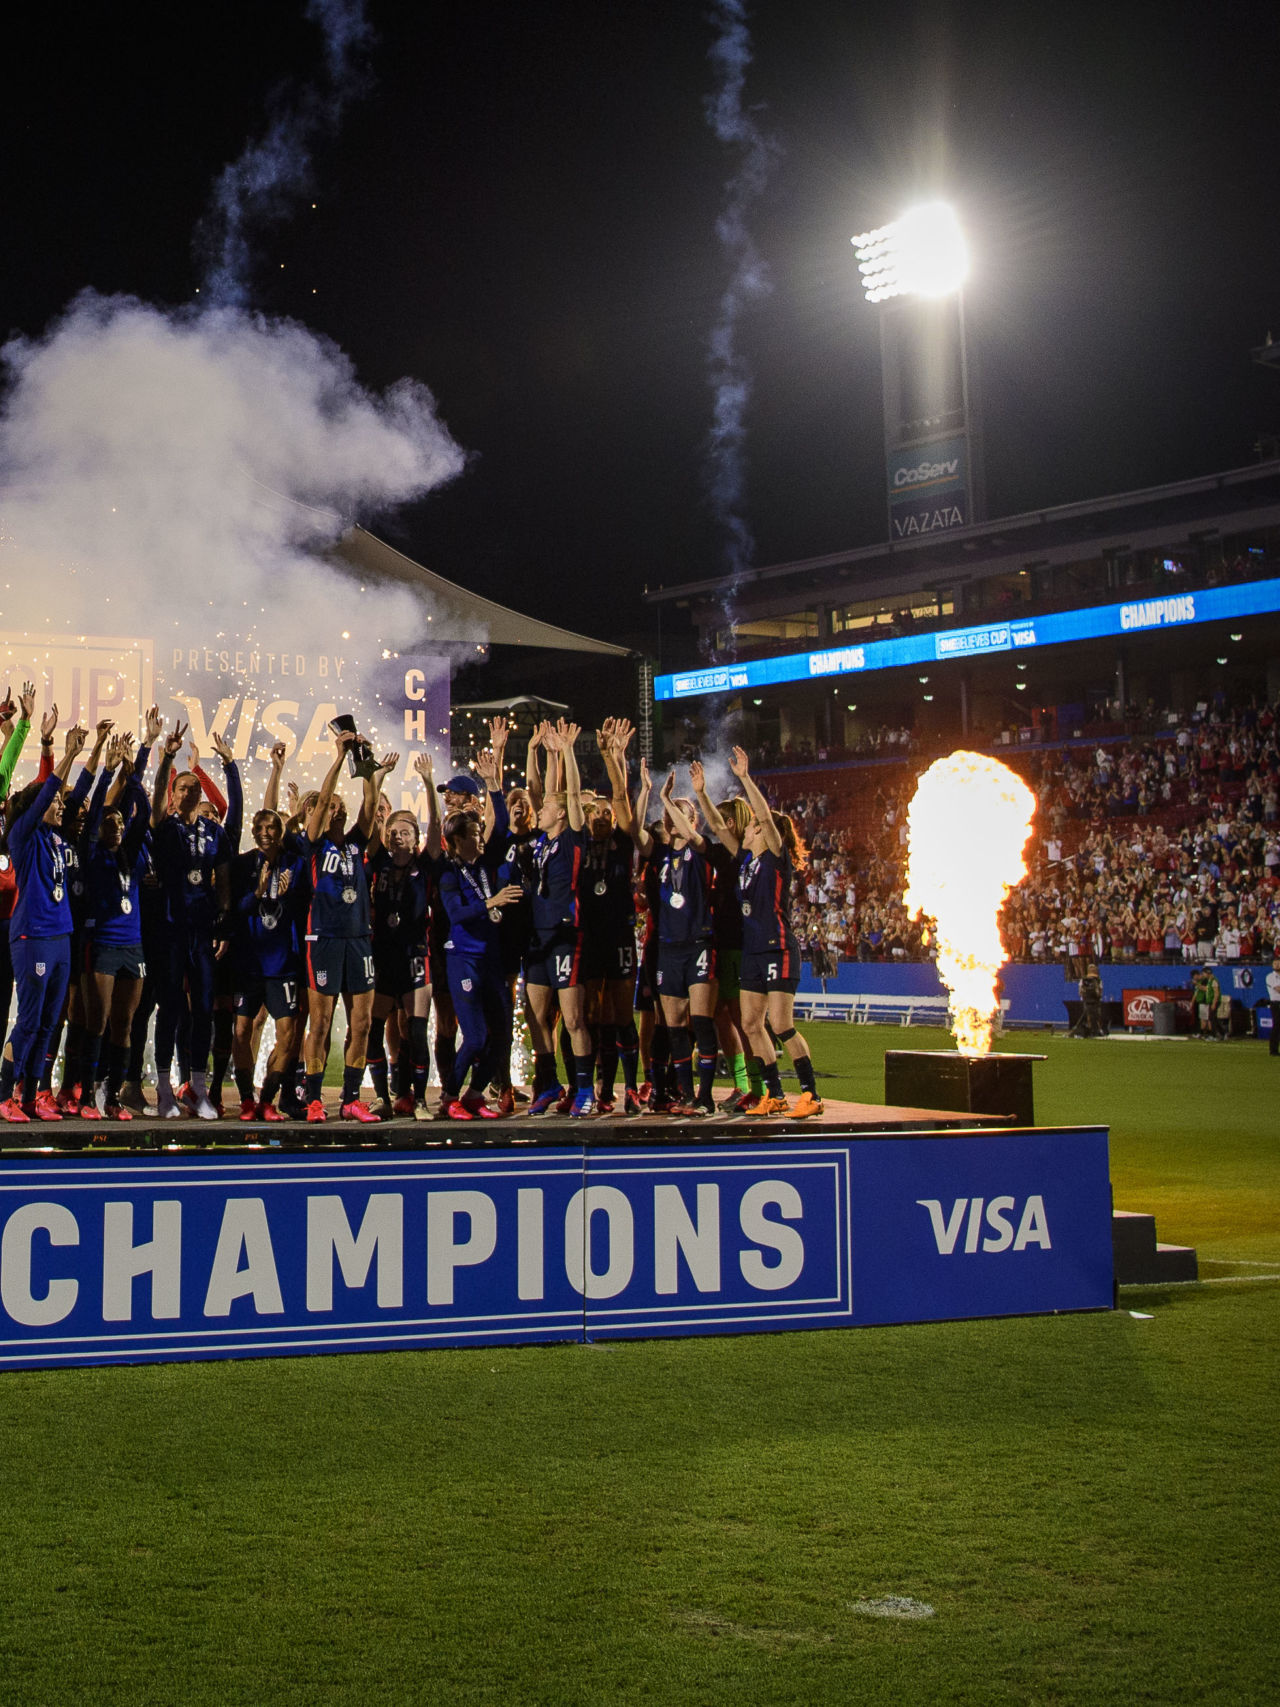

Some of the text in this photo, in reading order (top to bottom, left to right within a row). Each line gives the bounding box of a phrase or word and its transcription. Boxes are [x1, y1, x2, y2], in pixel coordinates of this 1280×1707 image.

[894, 459, 958, 486] CoServ
[894, 506, 963, 536] VAZATA
[1121, 596, 1195, 629] CHAMPIONS
[991, 630, 1007, 646] CUP
[1011, 630, 1036, 645] VISA
[173, 648, 345, 679] PRESENTED BY
[809, 648, 865, 675] CHAMPIONS
[639, 664, 652, 716] CORNER
[714, 673, 727, 686] CUP
[729, 673, 748, 688] VISA
[169, 695, 341, 764] VISA
[322, 851, 340, 873] 10
[505, 844, 516, 862] 6
[660, 863, 669, 883] 4
[363, 955, 375, 978] 10
[410, 956, 424, 977] 16
[555, 955, 571, 976] 14
[618, 947, 633, 967] 13
[696, 949, 708, 970] 4
[767, 963, 777, 980] 5
[283, 981, 297, 1003] 17
[917, 1194, 1051, 1255] VISA
[1, 1178, 804, 1327] CHAMPIONS
